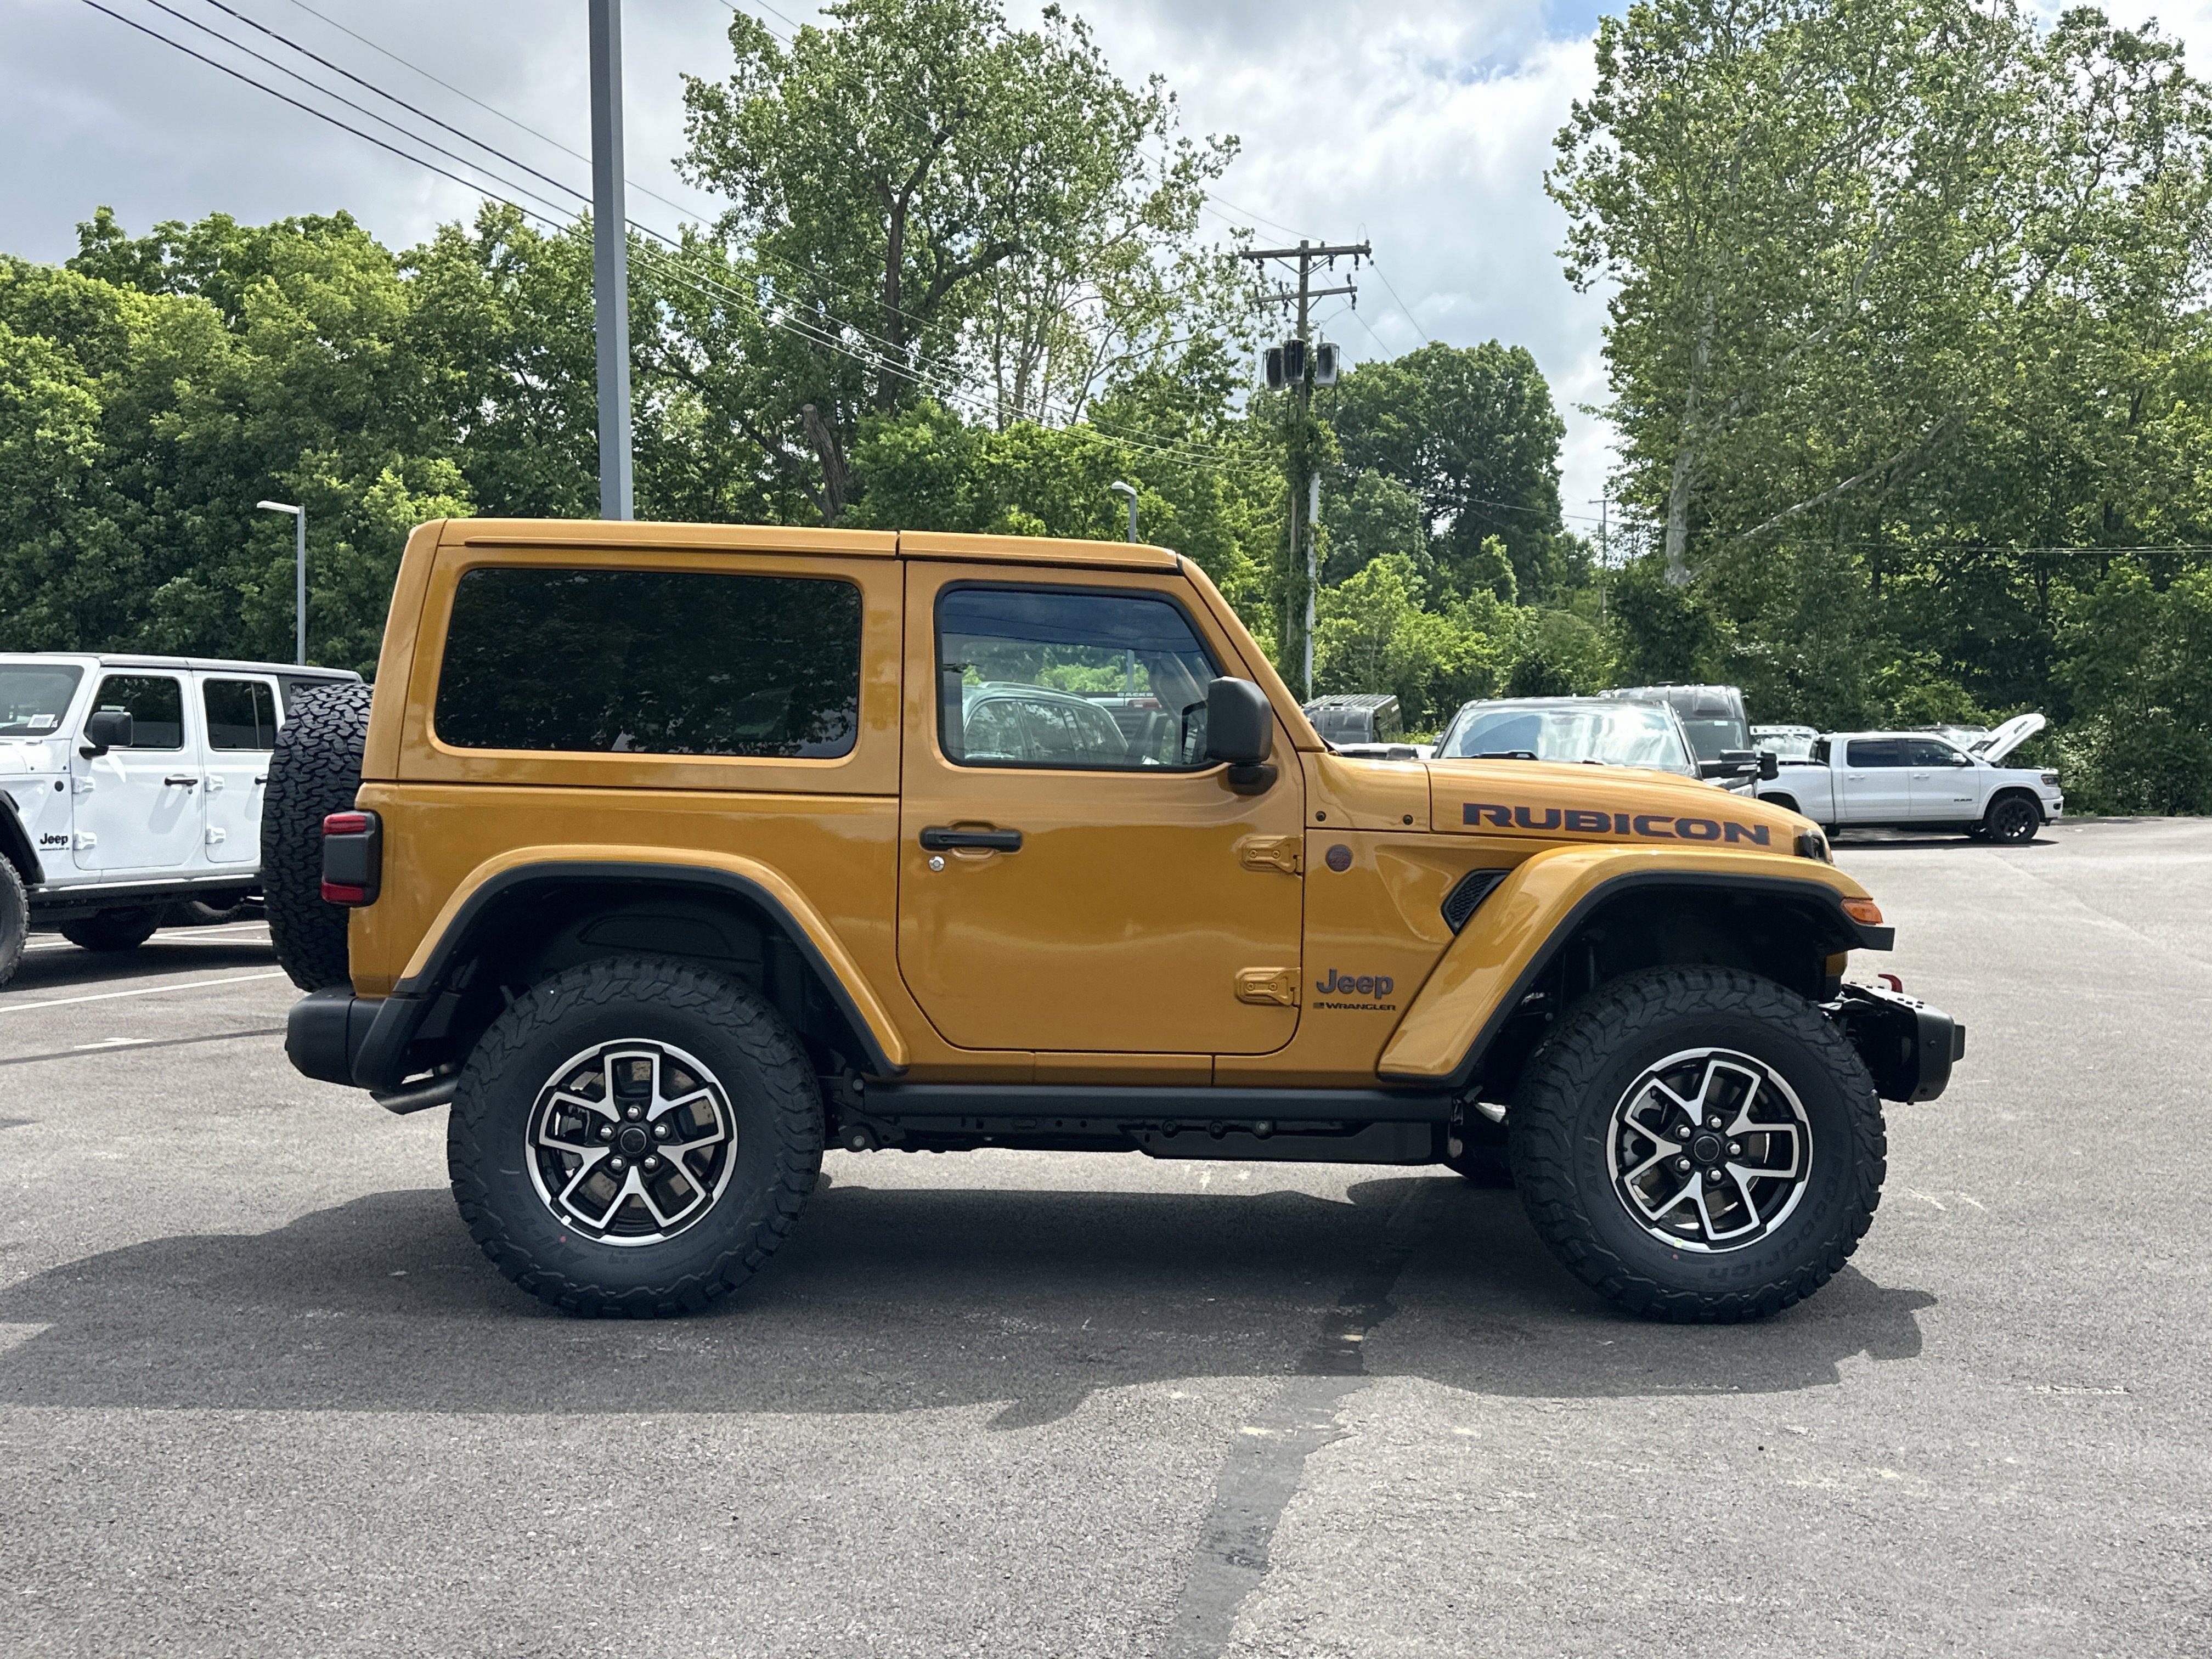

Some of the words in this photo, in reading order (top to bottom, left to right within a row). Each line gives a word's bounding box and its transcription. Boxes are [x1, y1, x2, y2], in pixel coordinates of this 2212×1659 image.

[1463, 803, 1770, 845] RUBICON
[40, 833, 68, 845] Jeep
[1317, 968, 1393, 1000] Jeep
[1325, 1002, 1396, 1011] WRANGLER
